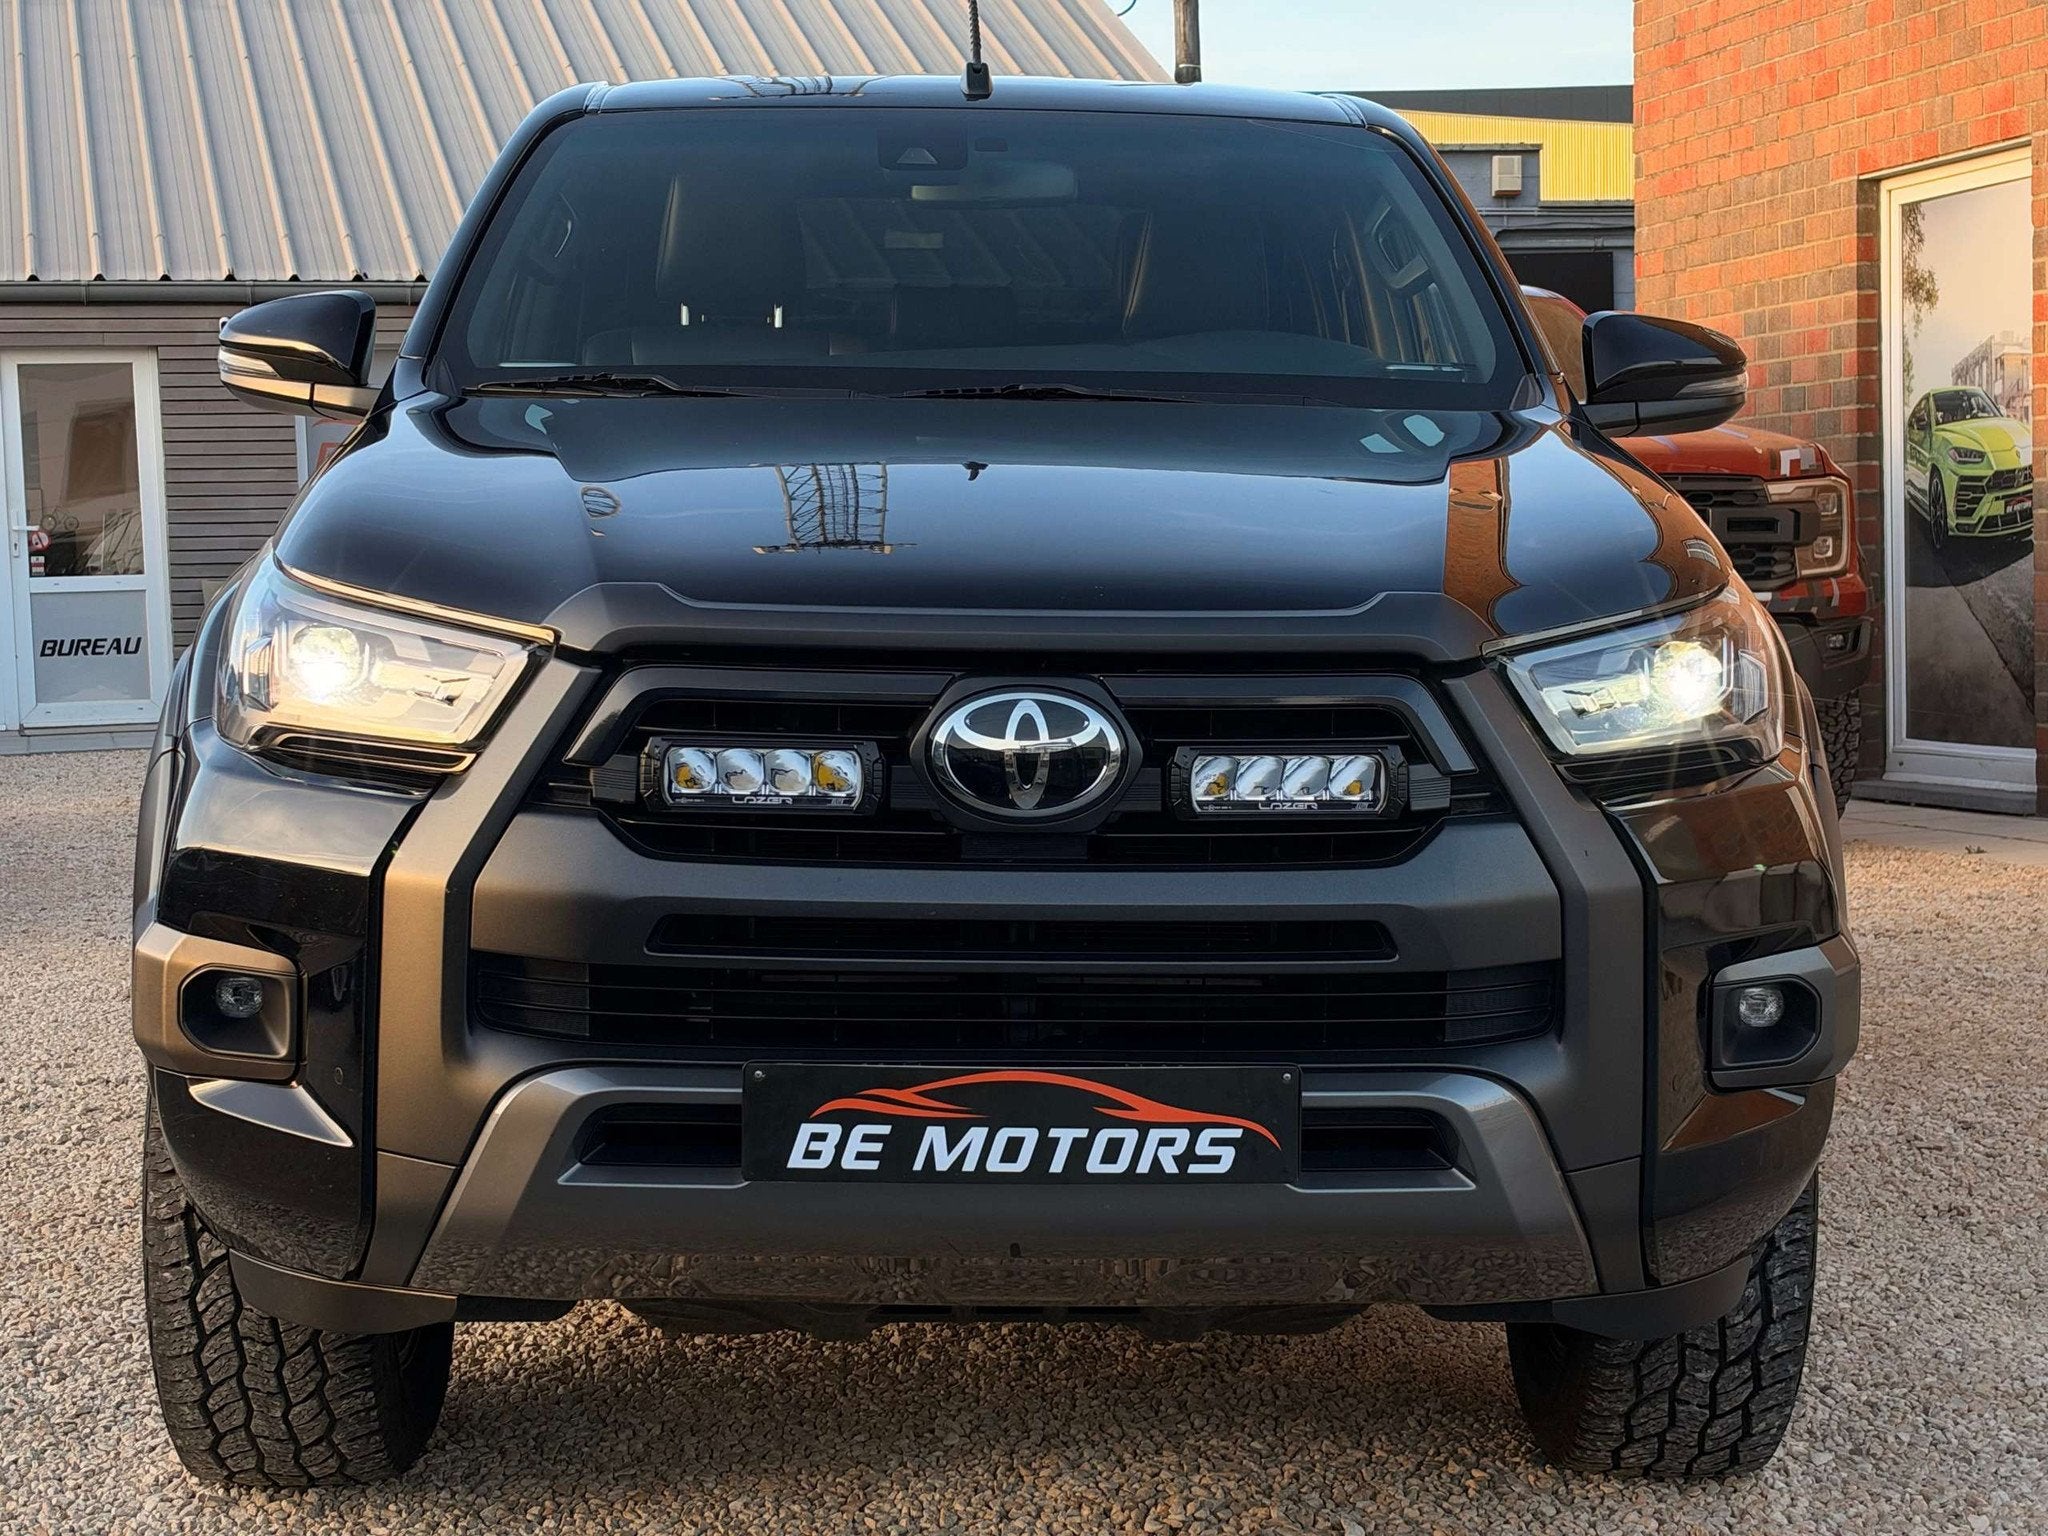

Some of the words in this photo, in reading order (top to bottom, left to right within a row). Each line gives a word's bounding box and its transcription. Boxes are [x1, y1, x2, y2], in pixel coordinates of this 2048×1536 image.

[40, 637, 142, 657] BUREAU
[786, 1122, 892, 1171] BE
[912, 1125, 1243, 1174] MOTORS
